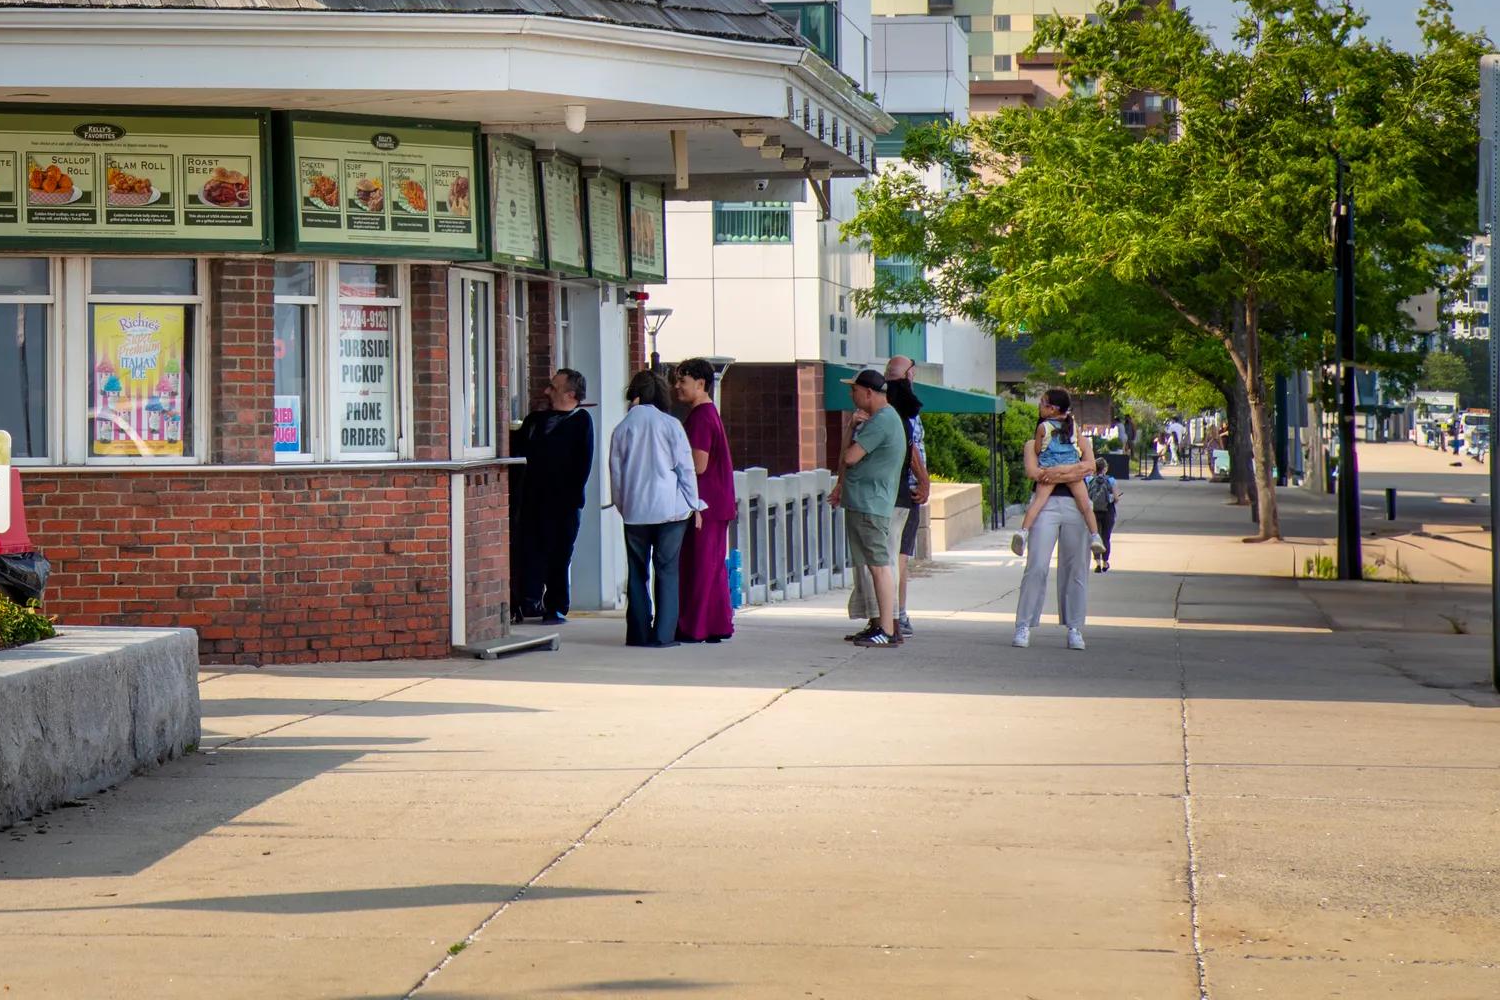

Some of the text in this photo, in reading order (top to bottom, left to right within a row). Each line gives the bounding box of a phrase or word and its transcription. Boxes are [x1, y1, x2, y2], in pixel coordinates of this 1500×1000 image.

[51, 156, 91, 165] SCALLOP
[110, 161, 166, 170] CLAM ROLL
[187, 158, 220, 166] ROAST
[67, 167, 90, 176] ROLL
[187, 166, 214, 174] BEEF
[434, 170, 460, 178] LOBSTER
[119, 312, 160, 331] Richie's
[121, 355, 156, 368] ITALIAN
[131, 367, 148, 379] ICE
[342, 365, 384, 383] PICKUP
[274, 408, 293, 423] RIED
[346, 402, 382, 421] PHONE
[274, 427, 297, 442] OUGH
[341, 427, 386, 447] ORDERS
